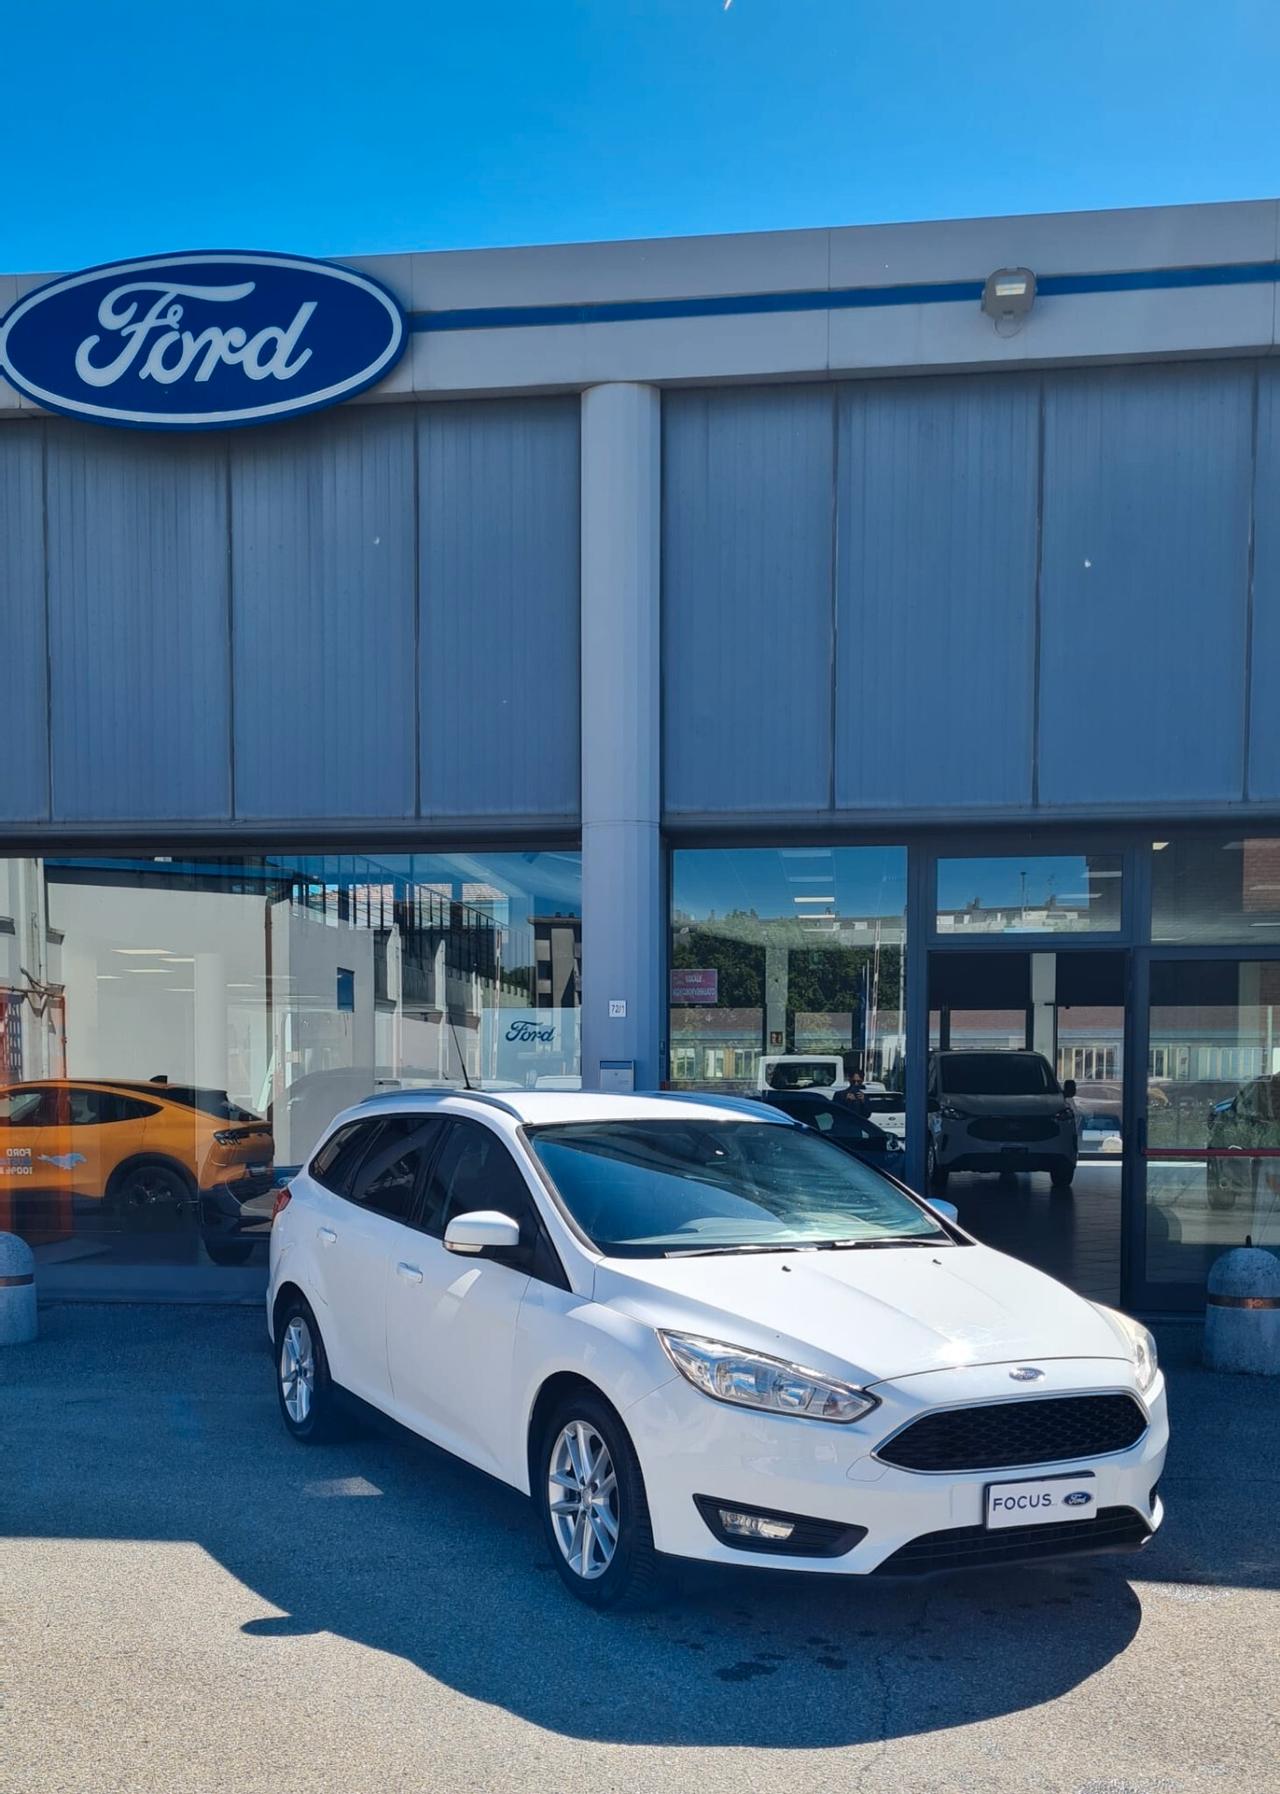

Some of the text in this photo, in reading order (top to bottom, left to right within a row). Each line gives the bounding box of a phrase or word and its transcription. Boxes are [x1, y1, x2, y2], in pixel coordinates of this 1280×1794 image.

[75, 281, 318, 387] Ford
[505, 1020, 557, 1042] Ford
[993, 1493, 1052, 1511] FOCUS
